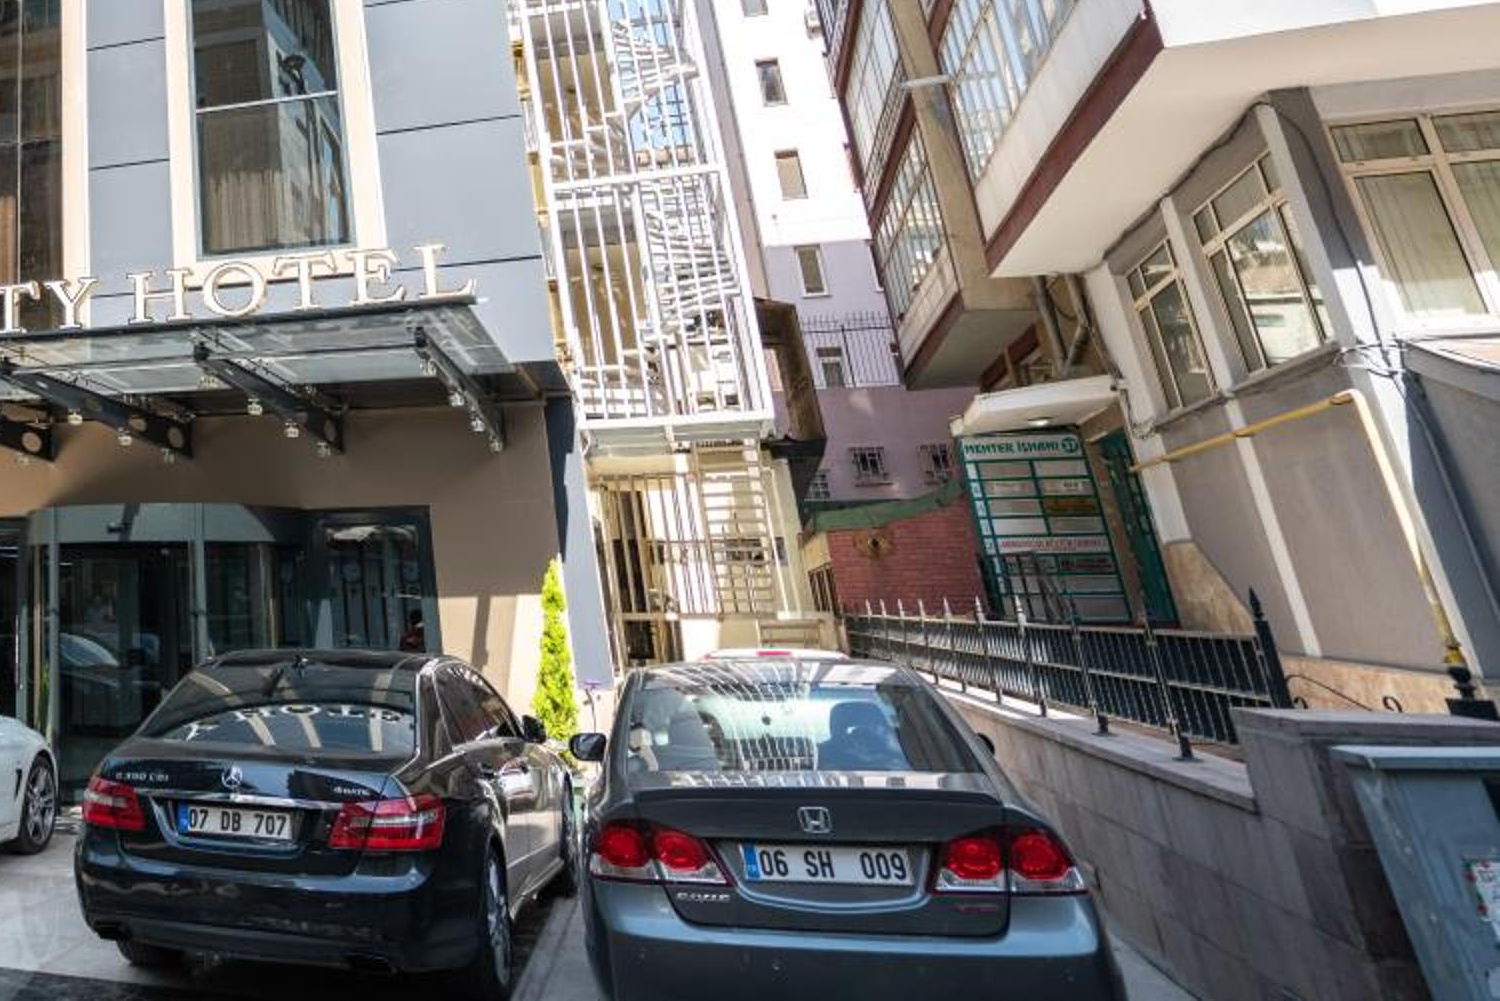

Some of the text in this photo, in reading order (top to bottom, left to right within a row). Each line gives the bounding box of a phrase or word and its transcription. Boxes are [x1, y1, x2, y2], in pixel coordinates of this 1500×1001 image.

[127, 243, 478, 325] HOTEL
[188, 806, 287, 836] 07 DB 707
[760, 850, 906, 881] 06 SH 009
